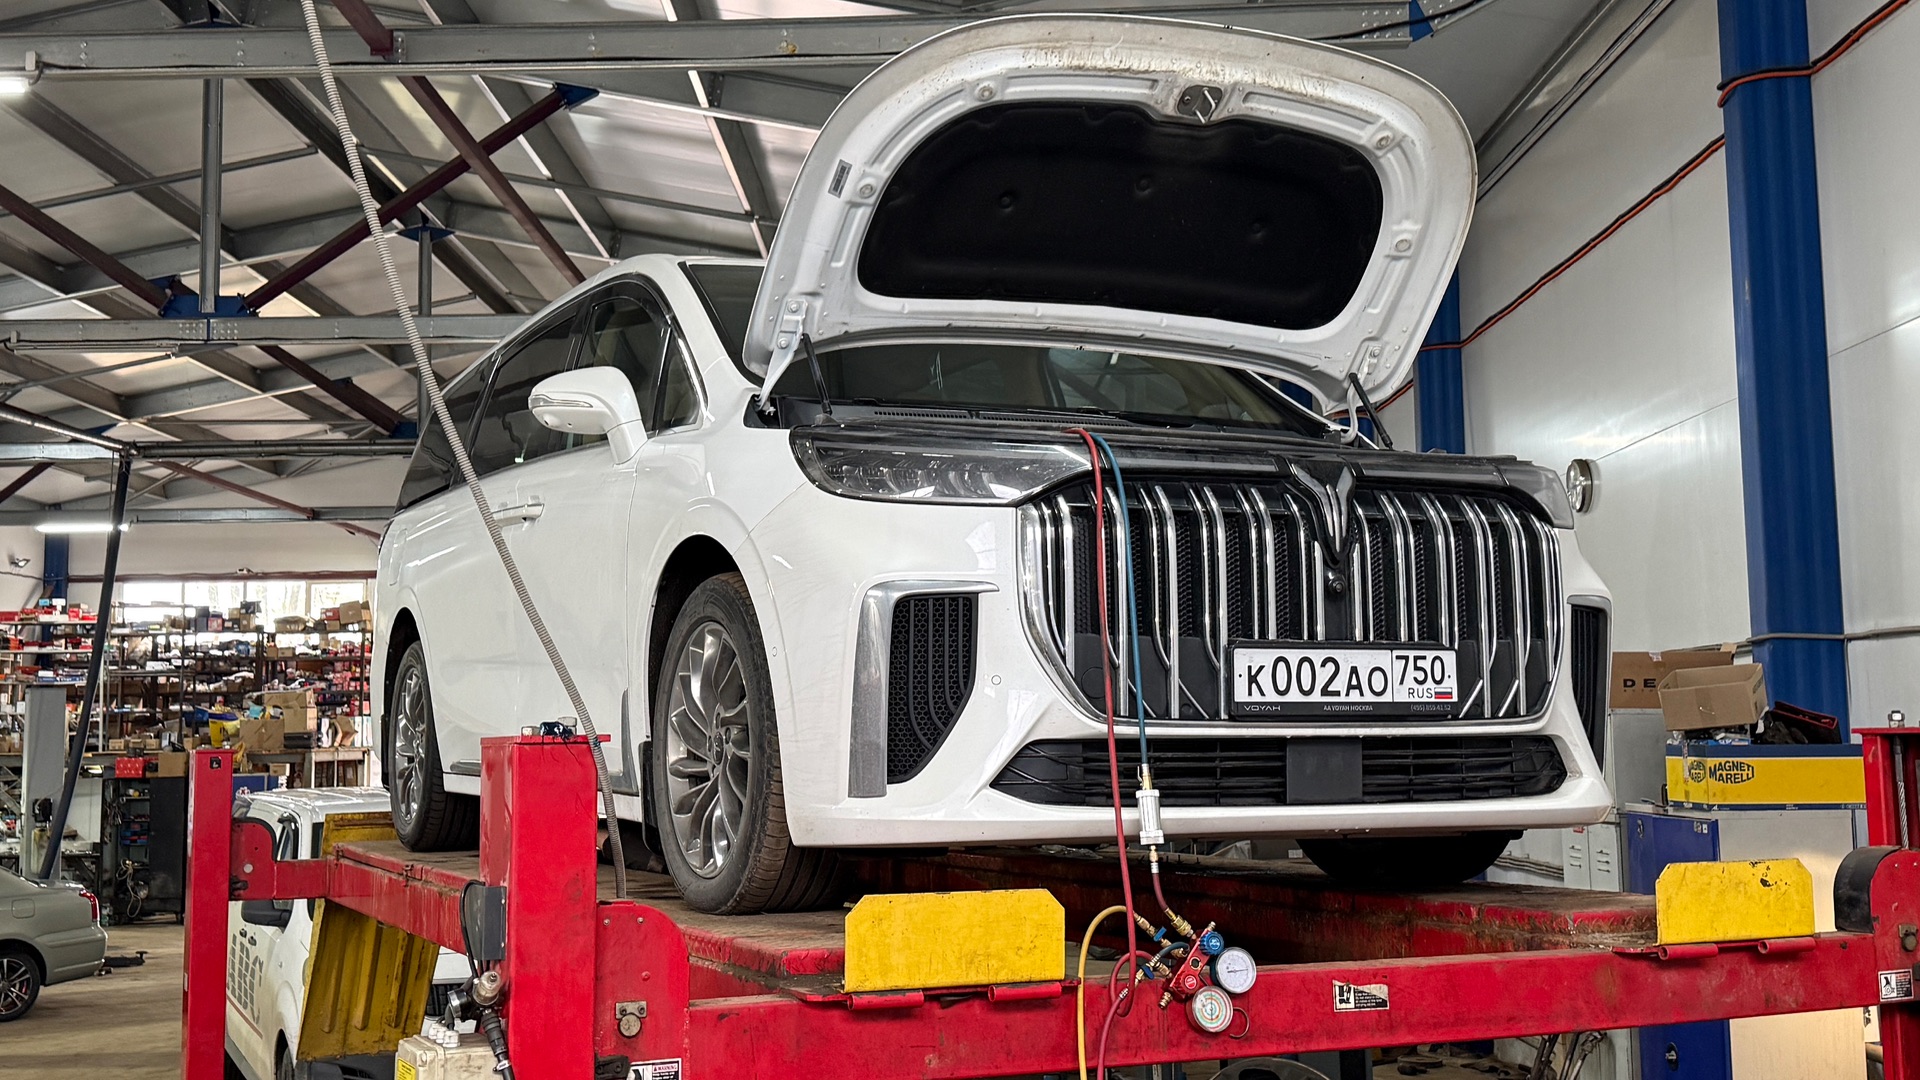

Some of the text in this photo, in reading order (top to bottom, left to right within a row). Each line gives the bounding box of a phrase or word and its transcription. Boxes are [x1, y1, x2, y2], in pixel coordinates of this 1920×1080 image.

[1247, 656, 1389, 697] K002AO
[1395, 655, 1445, 685] 750
[1408, 688, 1433, 698] RUS
[1709, 760, 1755, 775] MAGNETI
[1709, 770, 1755, 784] MARELLI
